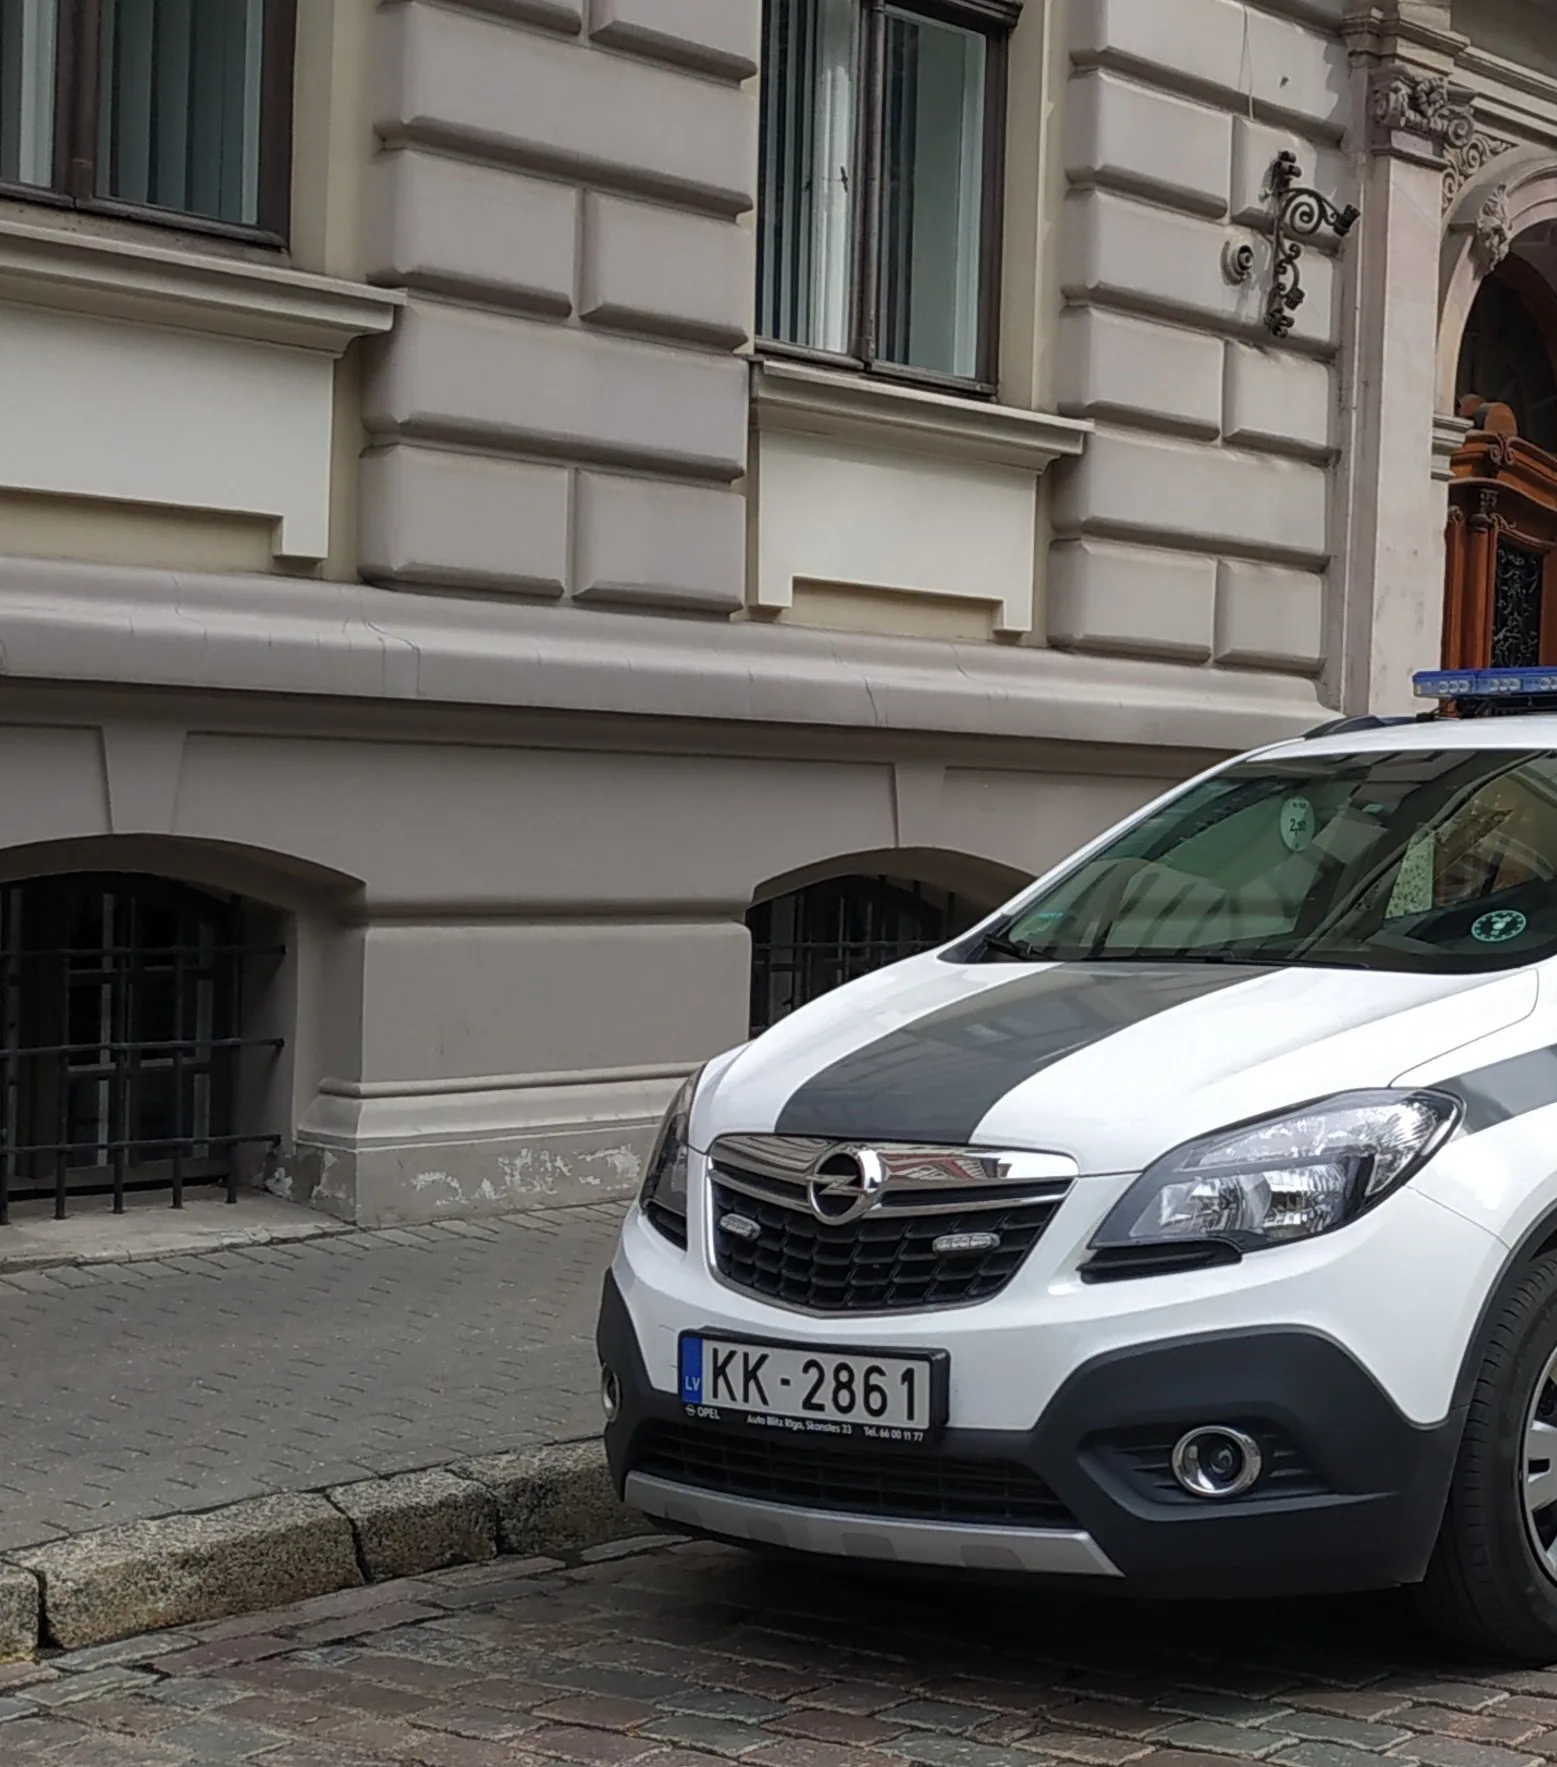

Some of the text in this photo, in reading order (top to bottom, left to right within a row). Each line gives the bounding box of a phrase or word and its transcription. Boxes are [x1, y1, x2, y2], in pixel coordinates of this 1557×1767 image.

[685, 1375, 700, 1391] LV
[711, 1347, 916, 1422] KK-2861
[696, 1406, 721, 1421] OPEL
[746, 1414, 766, 1426] Auto
[891, 1430, 901, 1440] 00
